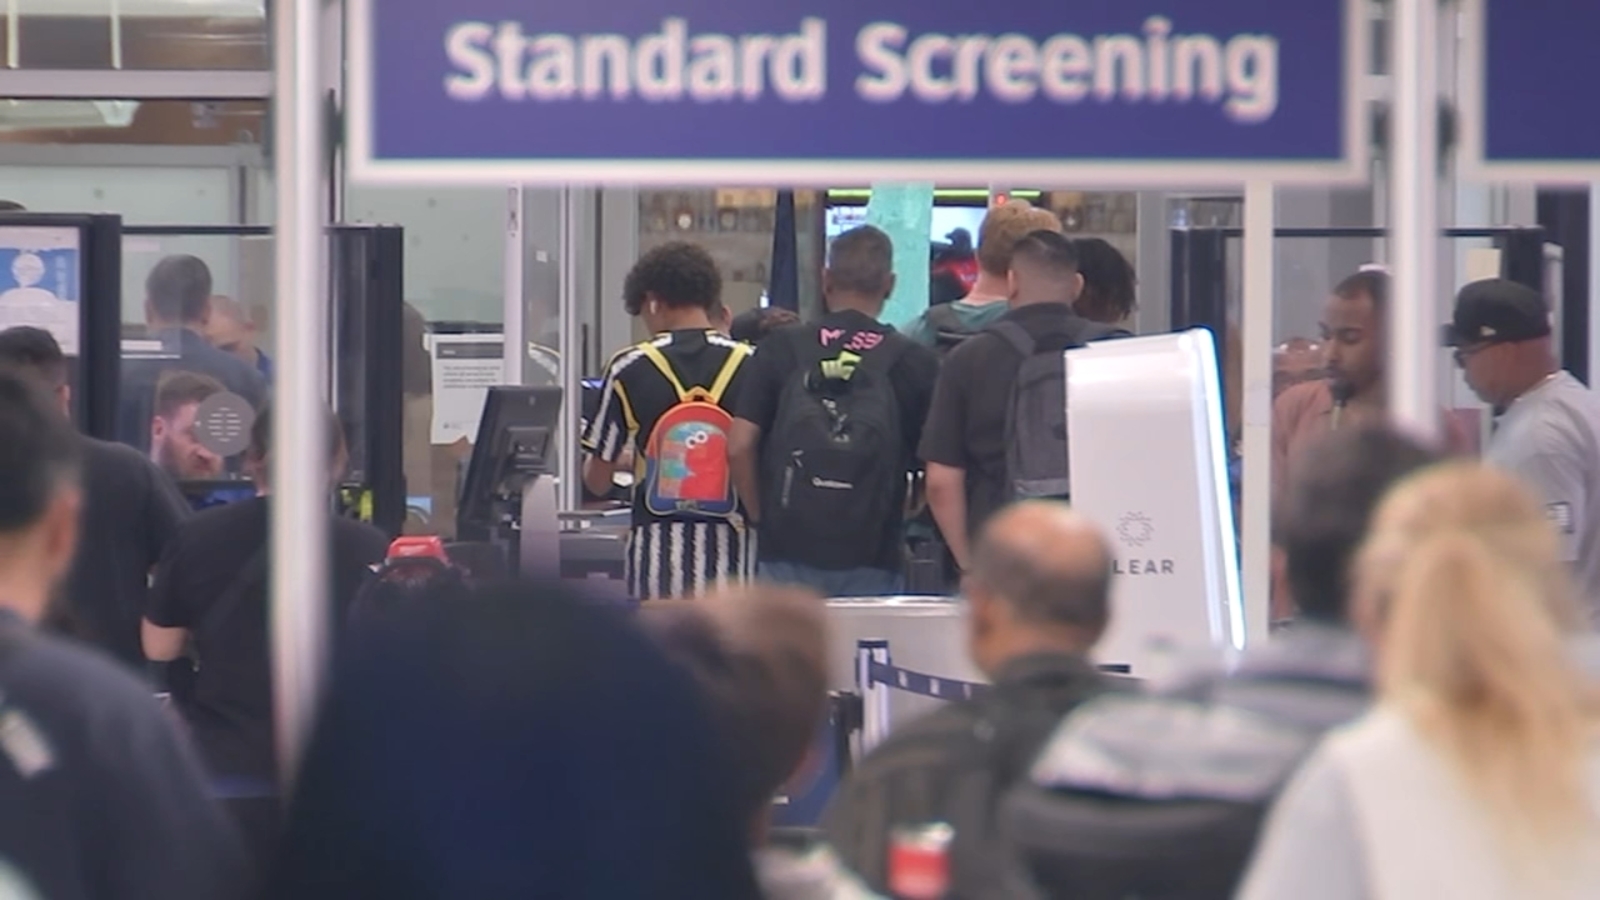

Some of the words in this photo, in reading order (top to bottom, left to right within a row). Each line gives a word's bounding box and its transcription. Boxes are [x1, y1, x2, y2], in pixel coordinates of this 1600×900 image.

[445, 18, 826, 102] Standard
[855, 17, 1279, 122] Screening
[820, 327, 884, 350] MSSI
[1112, 559, 1175, 575] LEAR
